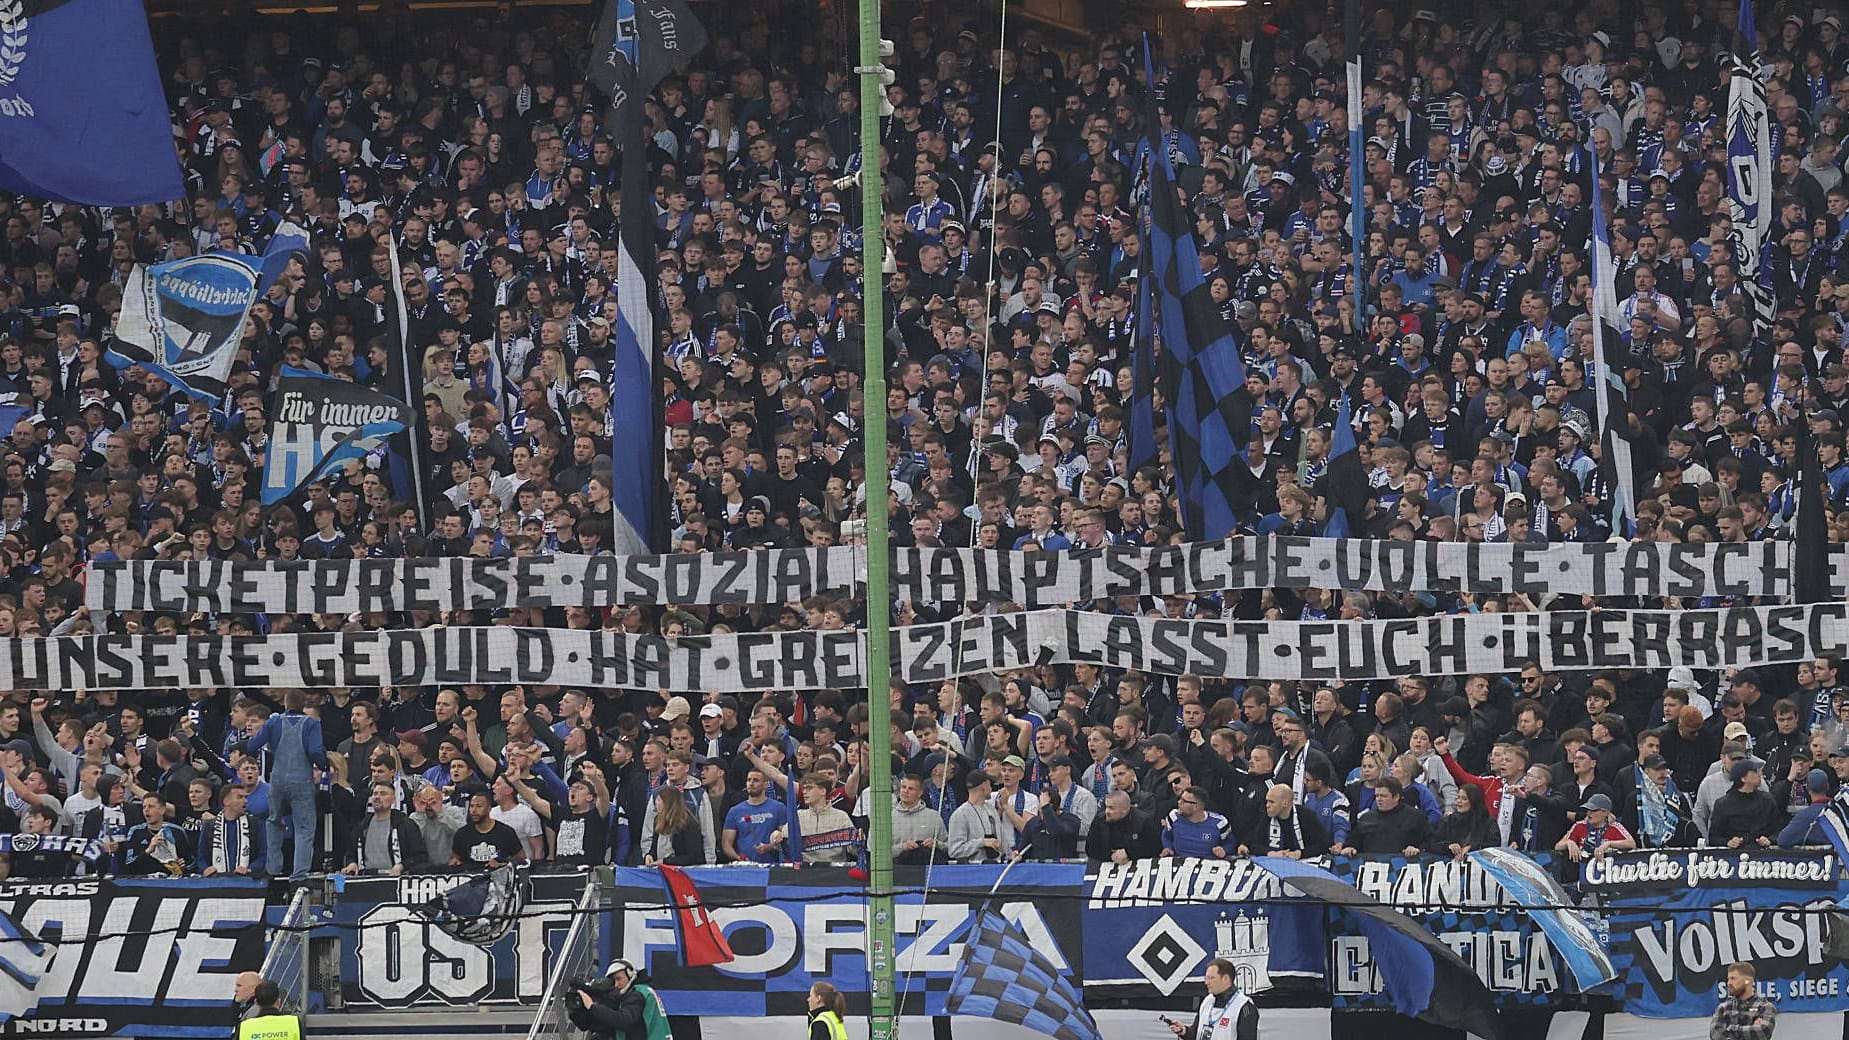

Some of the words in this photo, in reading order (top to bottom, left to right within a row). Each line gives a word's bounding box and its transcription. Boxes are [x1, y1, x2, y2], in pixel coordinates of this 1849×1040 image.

[280, 391, 315, 423] Für
[321, 397, 399, 426] immer
[92, 557, 553, 612] TICKETPREISE
[582, 547, 854, 605] ASOZIAL
[889, 536, 1310, 611] HAUPTSACHE
[1336, 539, 1549, 593] VOLLE
[10, 635, 270, 690] UNSERE
[300, 627, 553, 687] GEDULD
[589, 632, 711, 691] HAT
[1066, 611, 1269, 678] LASST
[1296, 617, 1466, 679] EUCH
[1585, 852, 1683, 885] Charlie
[1687, 852, 1734, 888] für
[1738, 853, 1834, 882] immer!
[357, 903, 576, 1006] OST
[1789, 977, 1839, 999] SIEGE
[15, 1018, 108, 1034] NORD
